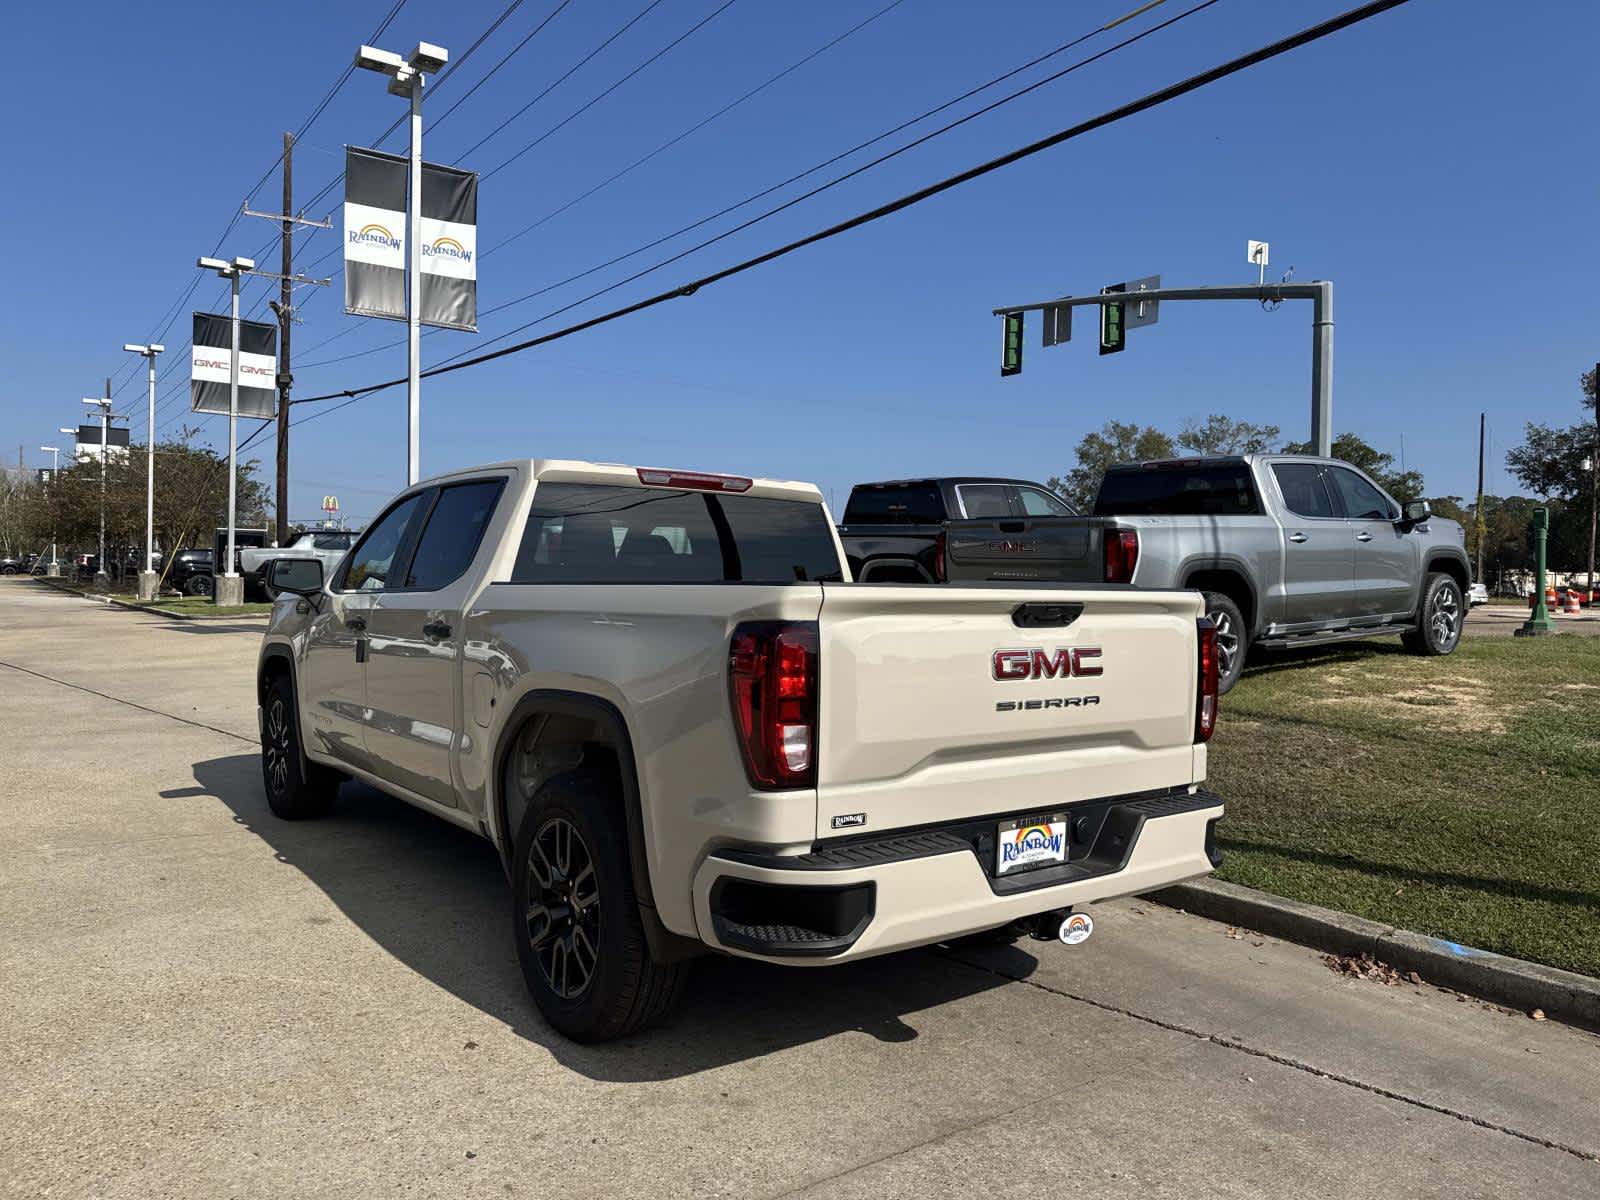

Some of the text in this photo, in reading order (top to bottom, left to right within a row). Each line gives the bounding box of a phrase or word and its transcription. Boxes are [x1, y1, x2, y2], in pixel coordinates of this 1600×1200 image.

[349, 230, 402, 251] RAINBOW
[422, 244, 472, 263] RAINBOW
[194, 359, 230, 370] GMC
[240, 365, 274, 376] GMC
[992, 647, 1103, 681] GMC
[996, 695, 1100, 712] SIERRA
[835, 815, 864, 827] RAINBOW
[1003, 834, 1062, 862] RAINBOW
[1063, 923, 1090, 938] RAINBOW
